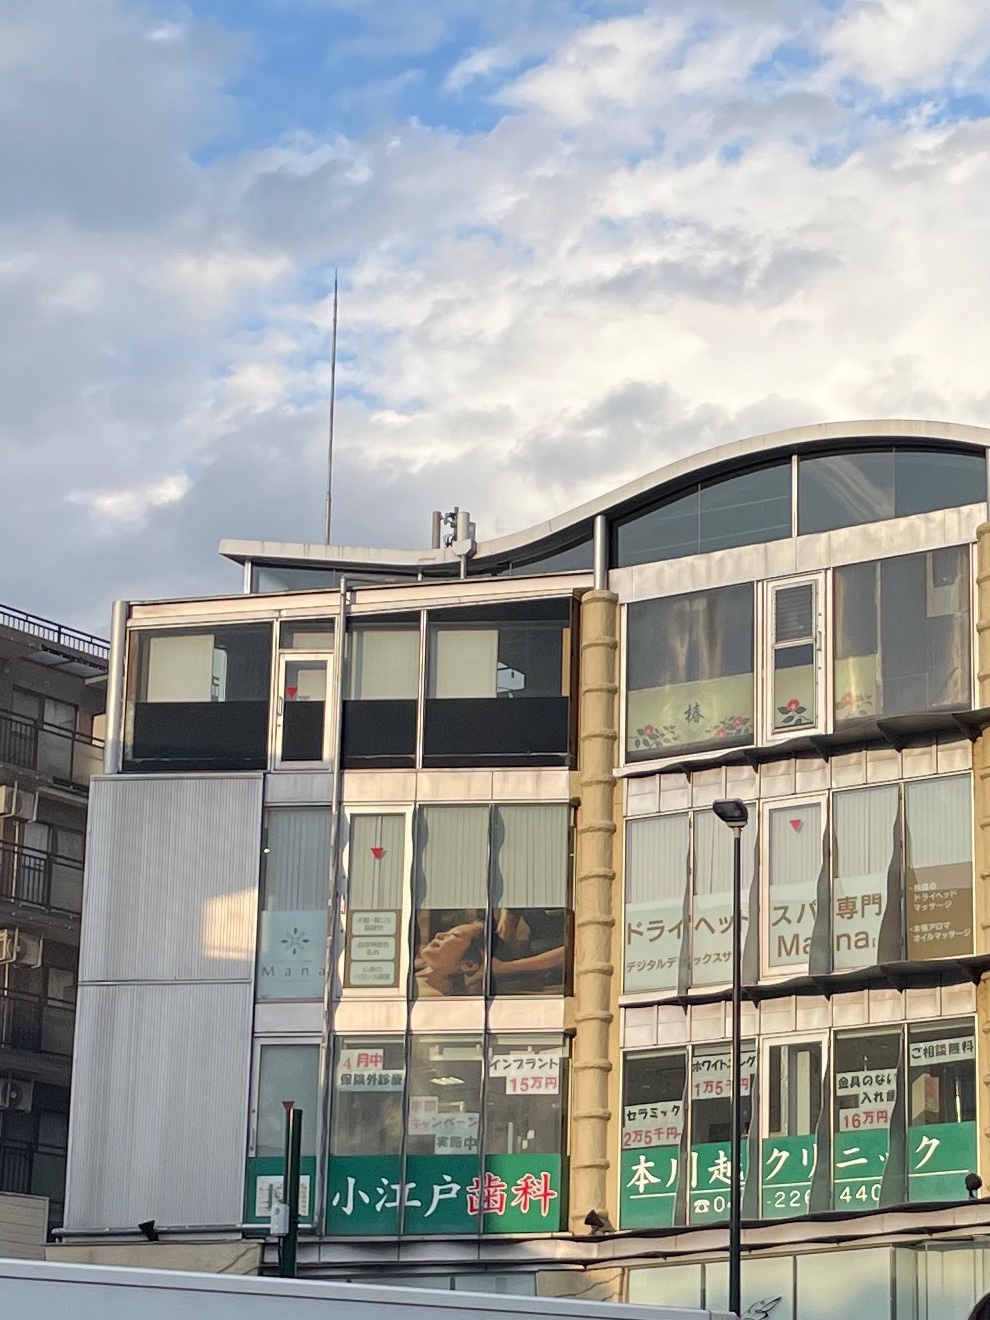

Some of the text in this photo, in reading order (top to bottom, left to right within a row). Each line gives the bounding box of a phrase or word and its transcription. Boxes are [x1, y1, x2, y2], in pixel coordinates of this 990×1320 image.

[685, 703, 705, 724] 椿
[913, 900, 953, 911] マッサージ
[911, 1040, 975, 1060] ご相談無料
[489, 1058, 559, 1071] インプラント
[509, 1075, 558, 1093] 15万円
[626, 1104, 681, 1122] セラミック
[843, 1109, 889, 1129] 16万円
[332, 1171, 559, 1218] 小江戸歯科
